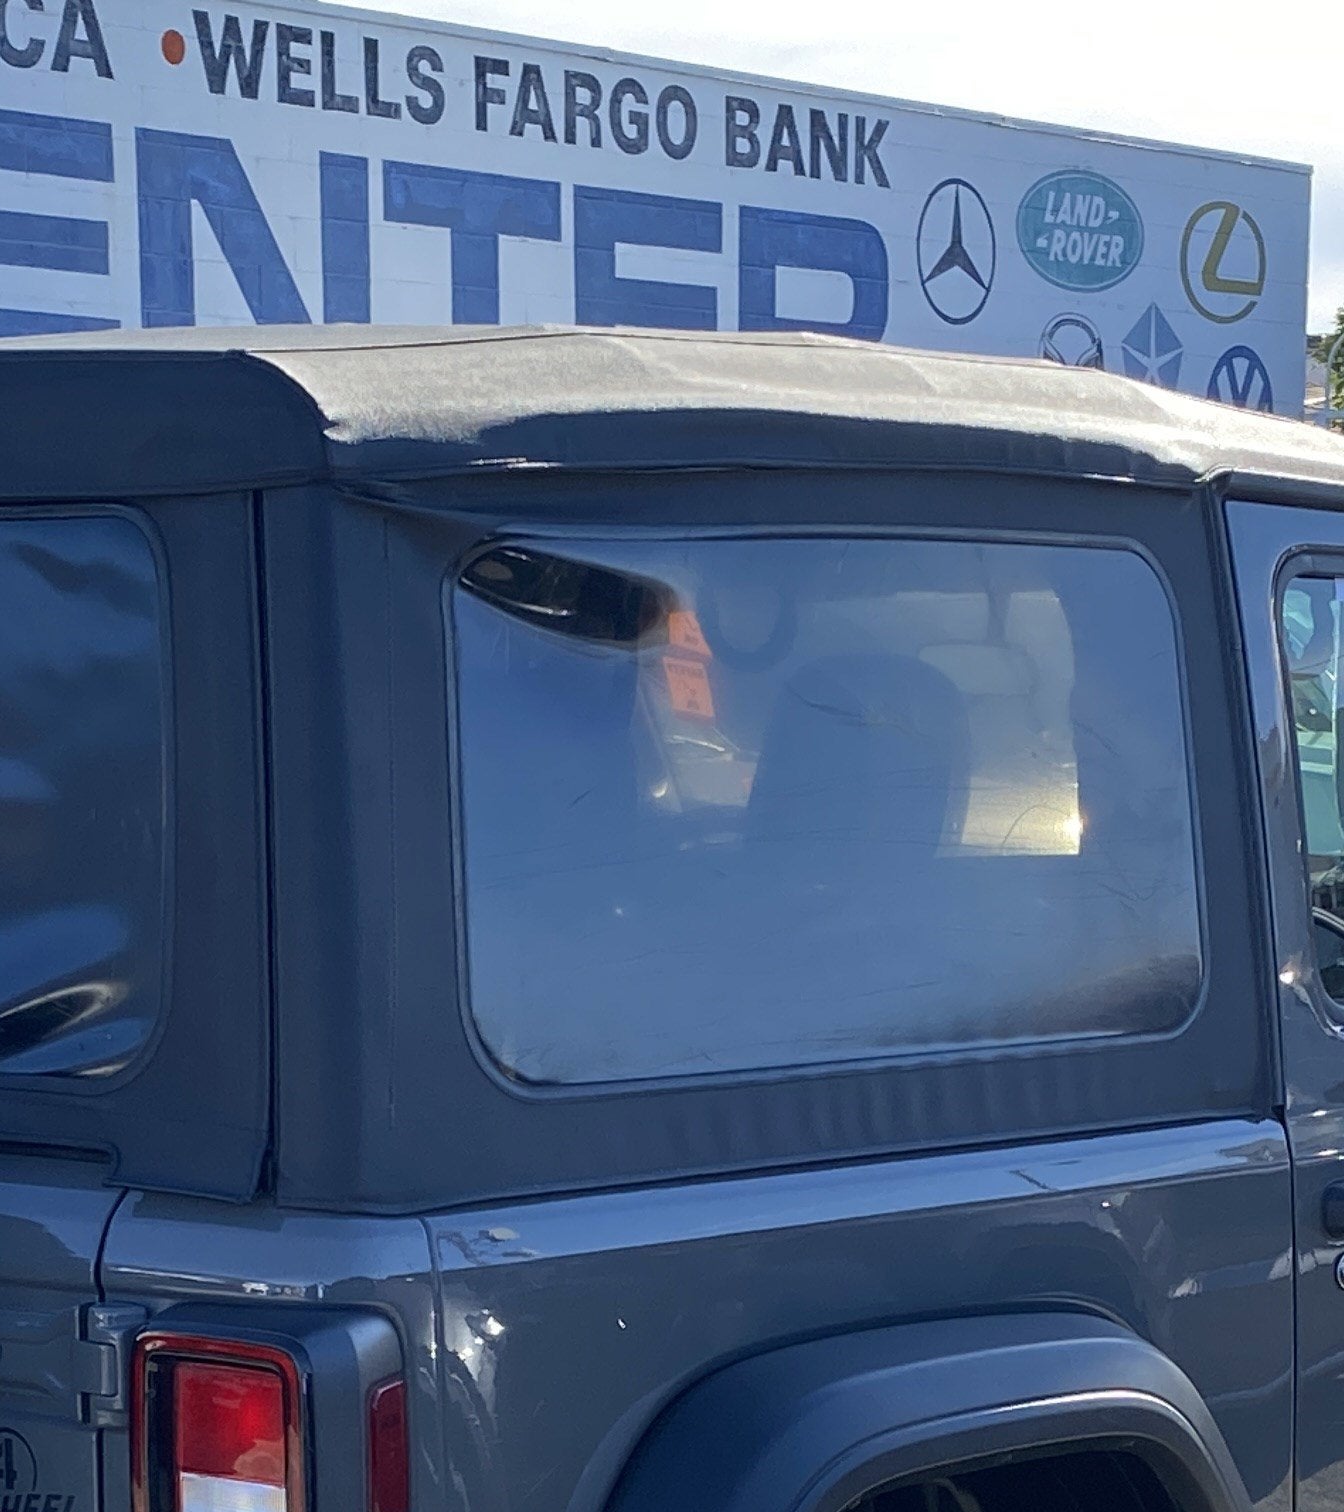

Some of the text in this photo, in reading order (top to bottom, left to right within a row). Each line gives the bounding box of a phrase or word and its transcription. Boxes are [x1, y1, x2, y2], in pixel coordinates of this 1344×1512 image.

[193, 9, 446, 125] WELLS
[472, 55, 698, 160] FARGO
[725, 94, 892, 188] BANK
[1044, 191, 1106, 228] LAND
[1048, 230, 1125, 268] ROVER
